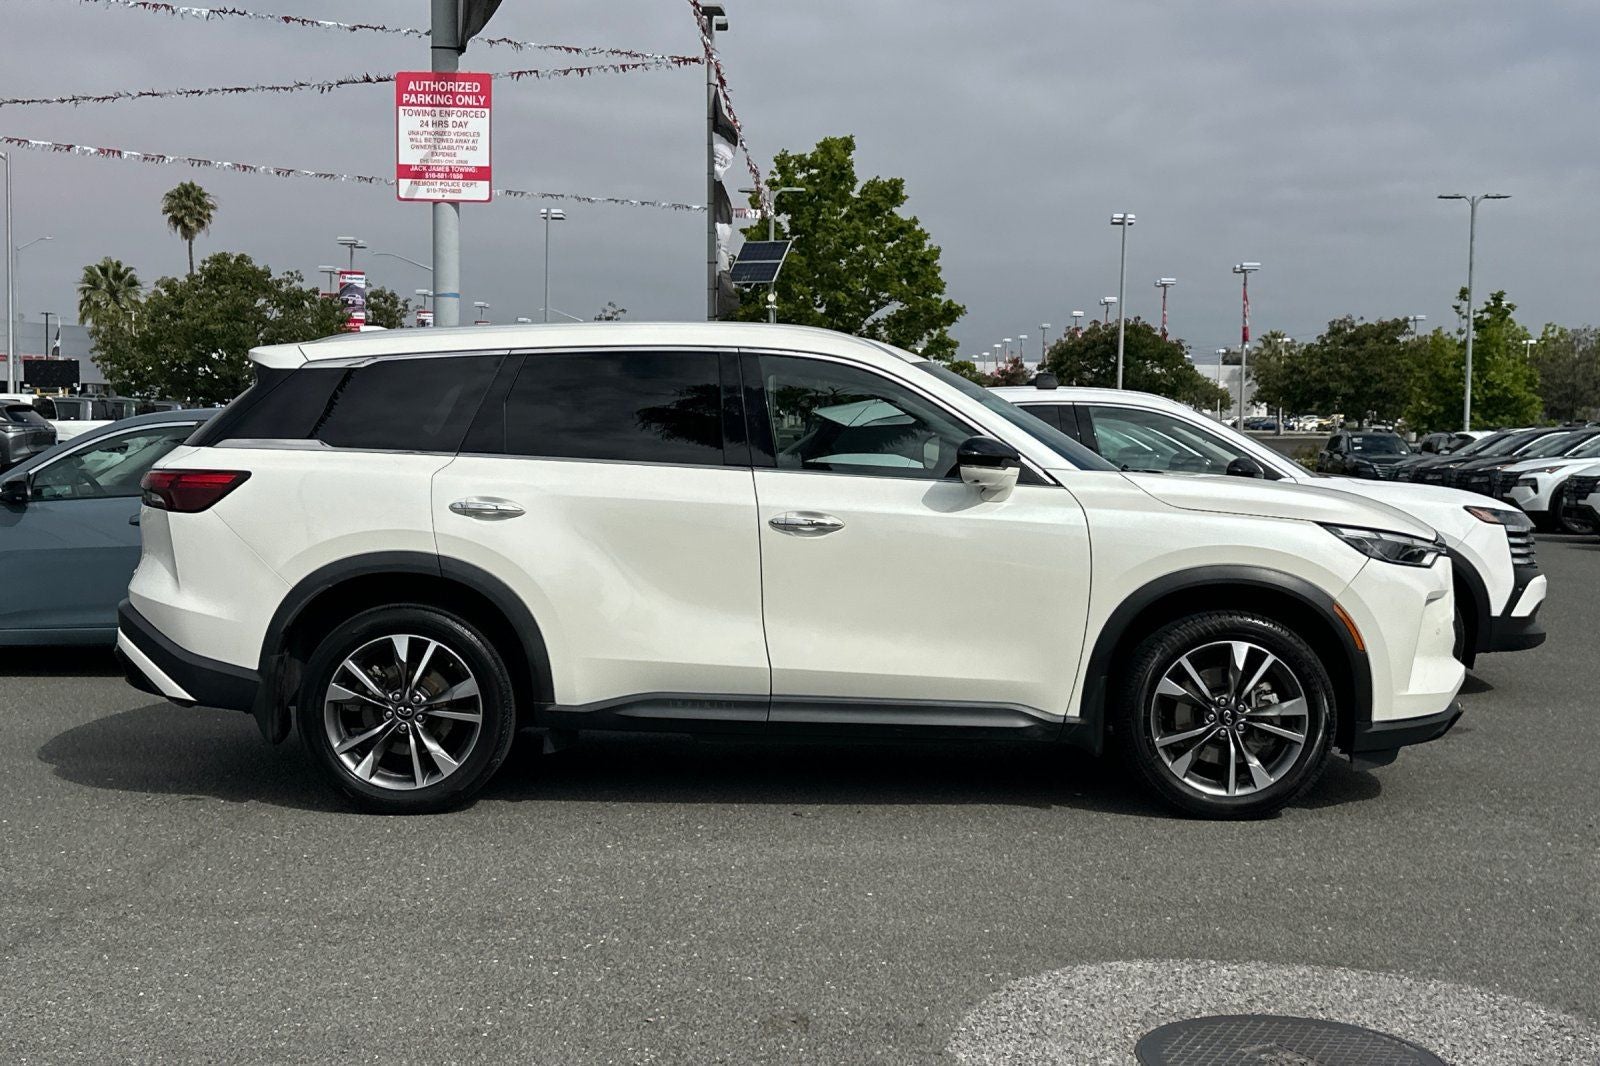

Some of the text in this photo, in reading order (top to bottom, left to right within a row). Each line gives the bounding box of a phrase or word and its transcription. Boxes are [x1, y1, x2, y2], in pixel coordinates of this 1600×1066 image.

[407, 80, 481, 93] AUTHORIZED
[402, 93, 486, 106] PARKING ONLY
[401, 108, 487, 119] TOWING ENFORCED
[419, 120, 469, 129] 24 HRS DAY
[428, 165, 450, 173] JAMES
